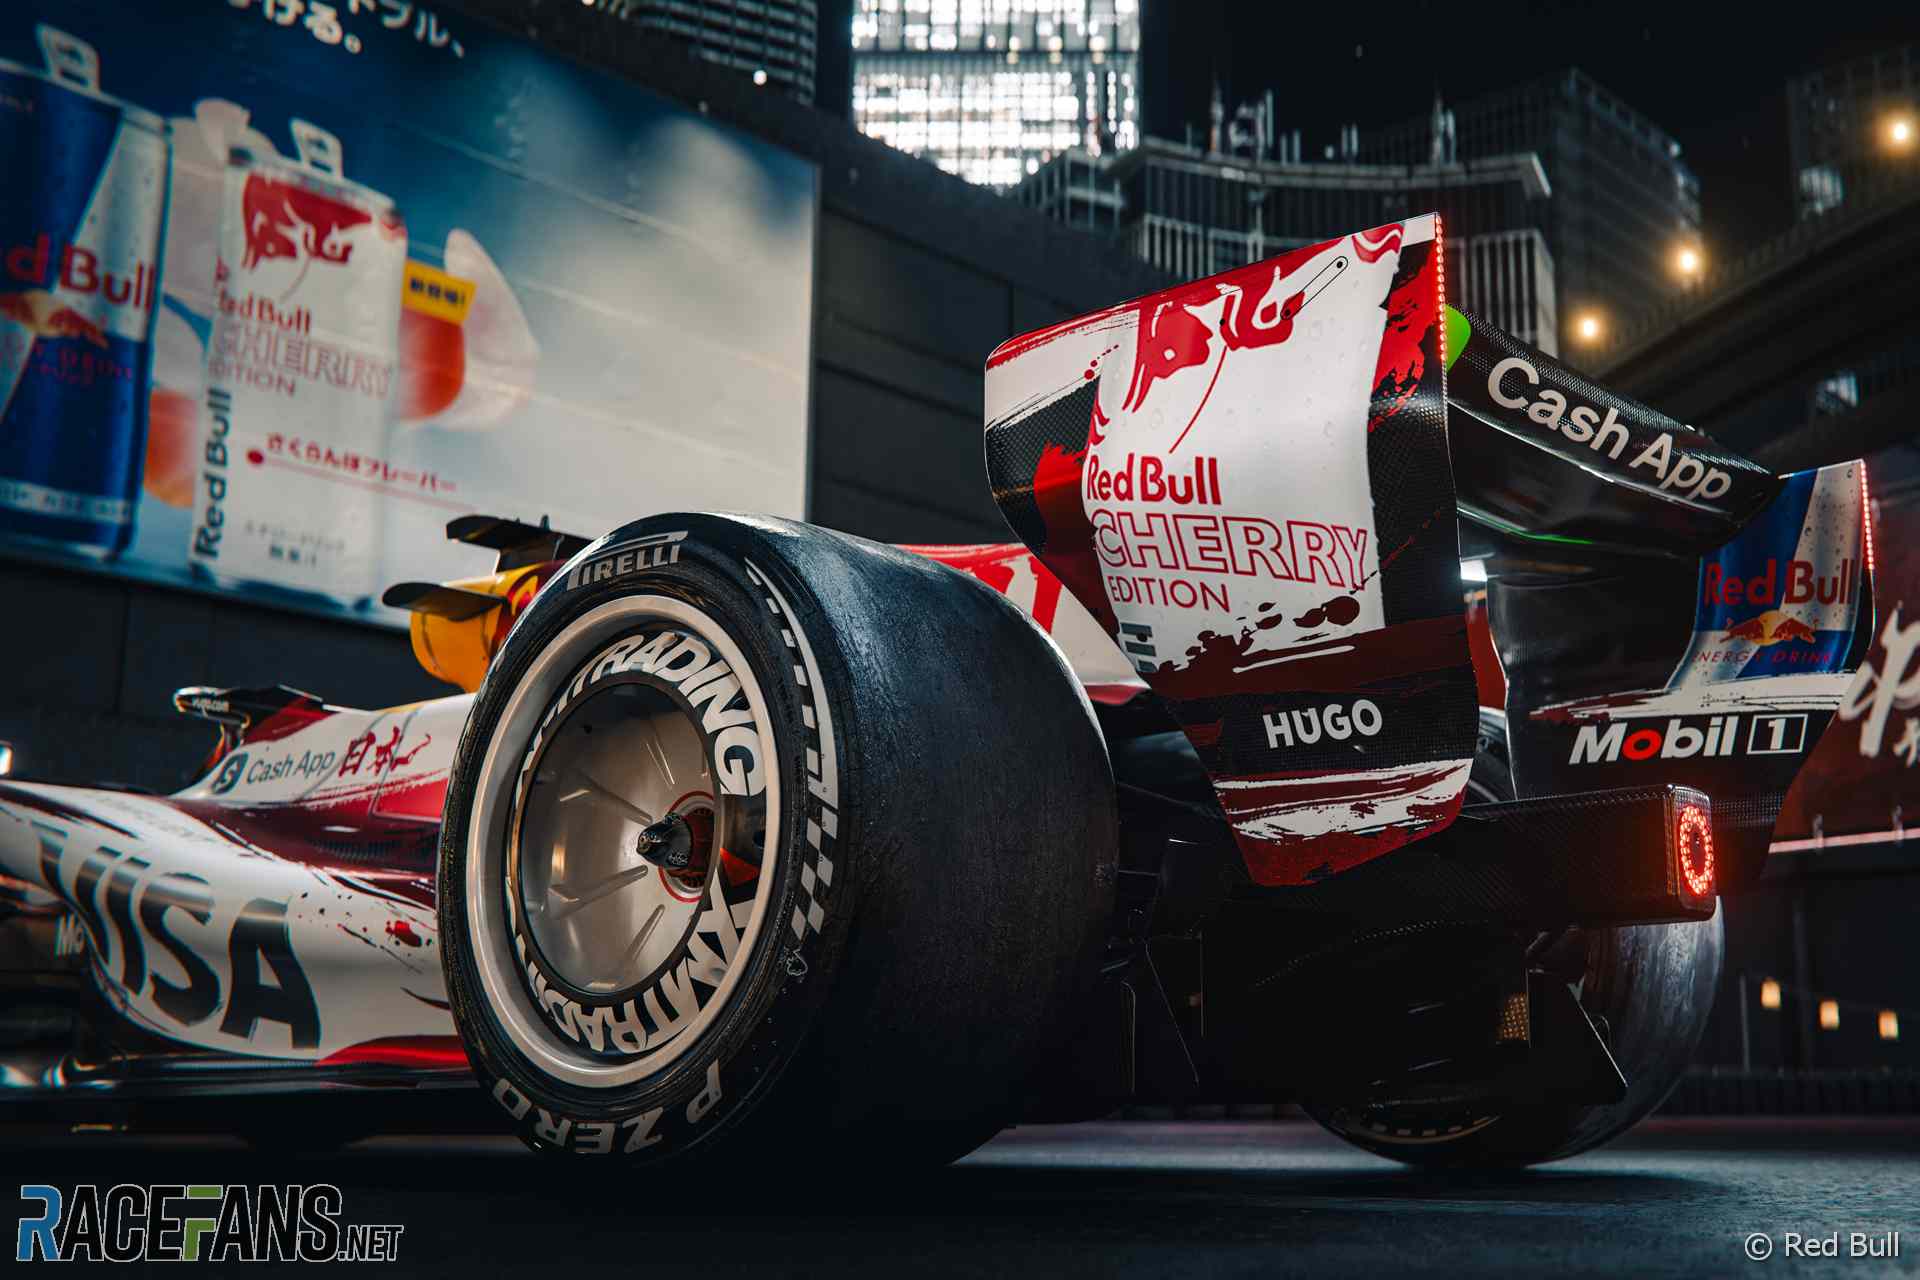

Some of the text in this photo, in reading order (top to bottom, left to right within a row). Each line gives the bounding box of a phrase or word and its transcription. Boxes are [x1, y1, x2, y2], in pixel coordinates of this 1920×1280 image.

[60, 242, 155, 314] Bull
[257, 298, 311, 335] Bull
[1487, 357, 1732, 501] Cash App
[194, 387, 232, 558] Red Bull
[1087, 453, 1222, 506] Red Bull
[567, 531, 689, 591] PIRELLI
[1091, 508, 1368, 592] CHERRY
[1108, 574, 1231, 614] EDITION
[1703, 557, 1855, 607] Red Bull
[1262, 699, 1384, 750] HUGO
[1568, 717, 1738, 767] Mobil
[246, 757, 293, 786] Cash
[293, 750, 336, 780] App
[30, 819, 322, 1050] VISA
[492, 1058, 723, 1155] P ZERO
